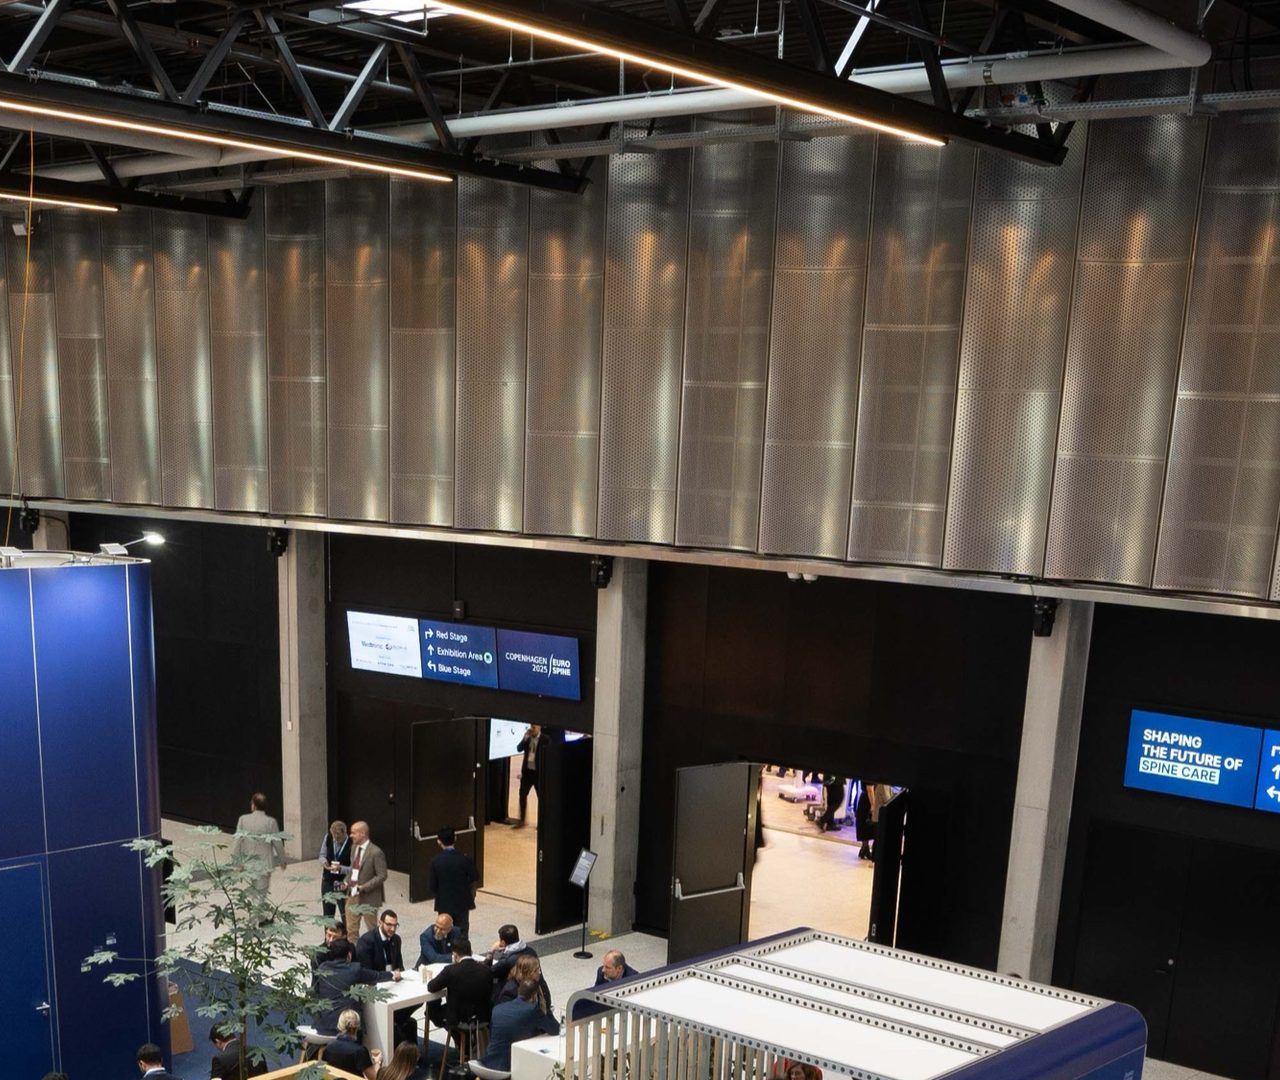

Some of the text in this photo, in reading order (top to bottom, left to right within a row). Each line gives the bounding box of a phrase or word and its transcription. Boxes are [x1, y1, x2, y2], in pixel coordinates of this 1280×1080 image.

[436, 630, 467, 643] Red Stage
[437, 647, 483, 661] Exhibition Area
[505, 652, 548, 665] COPENHAGEN
[532, 665, 548, 673] 2025
[553, 659, 570, 668] EURO
[438, 664, 471, 677] Blue Stage
[552, 668, 571, 676] SPINE
[1143, 729, 1202, 748] SHAPING
[1142, 744, 1243, 771] THE FUTURE OF
[1141, 760, 1217, 782] SPINE CARE
